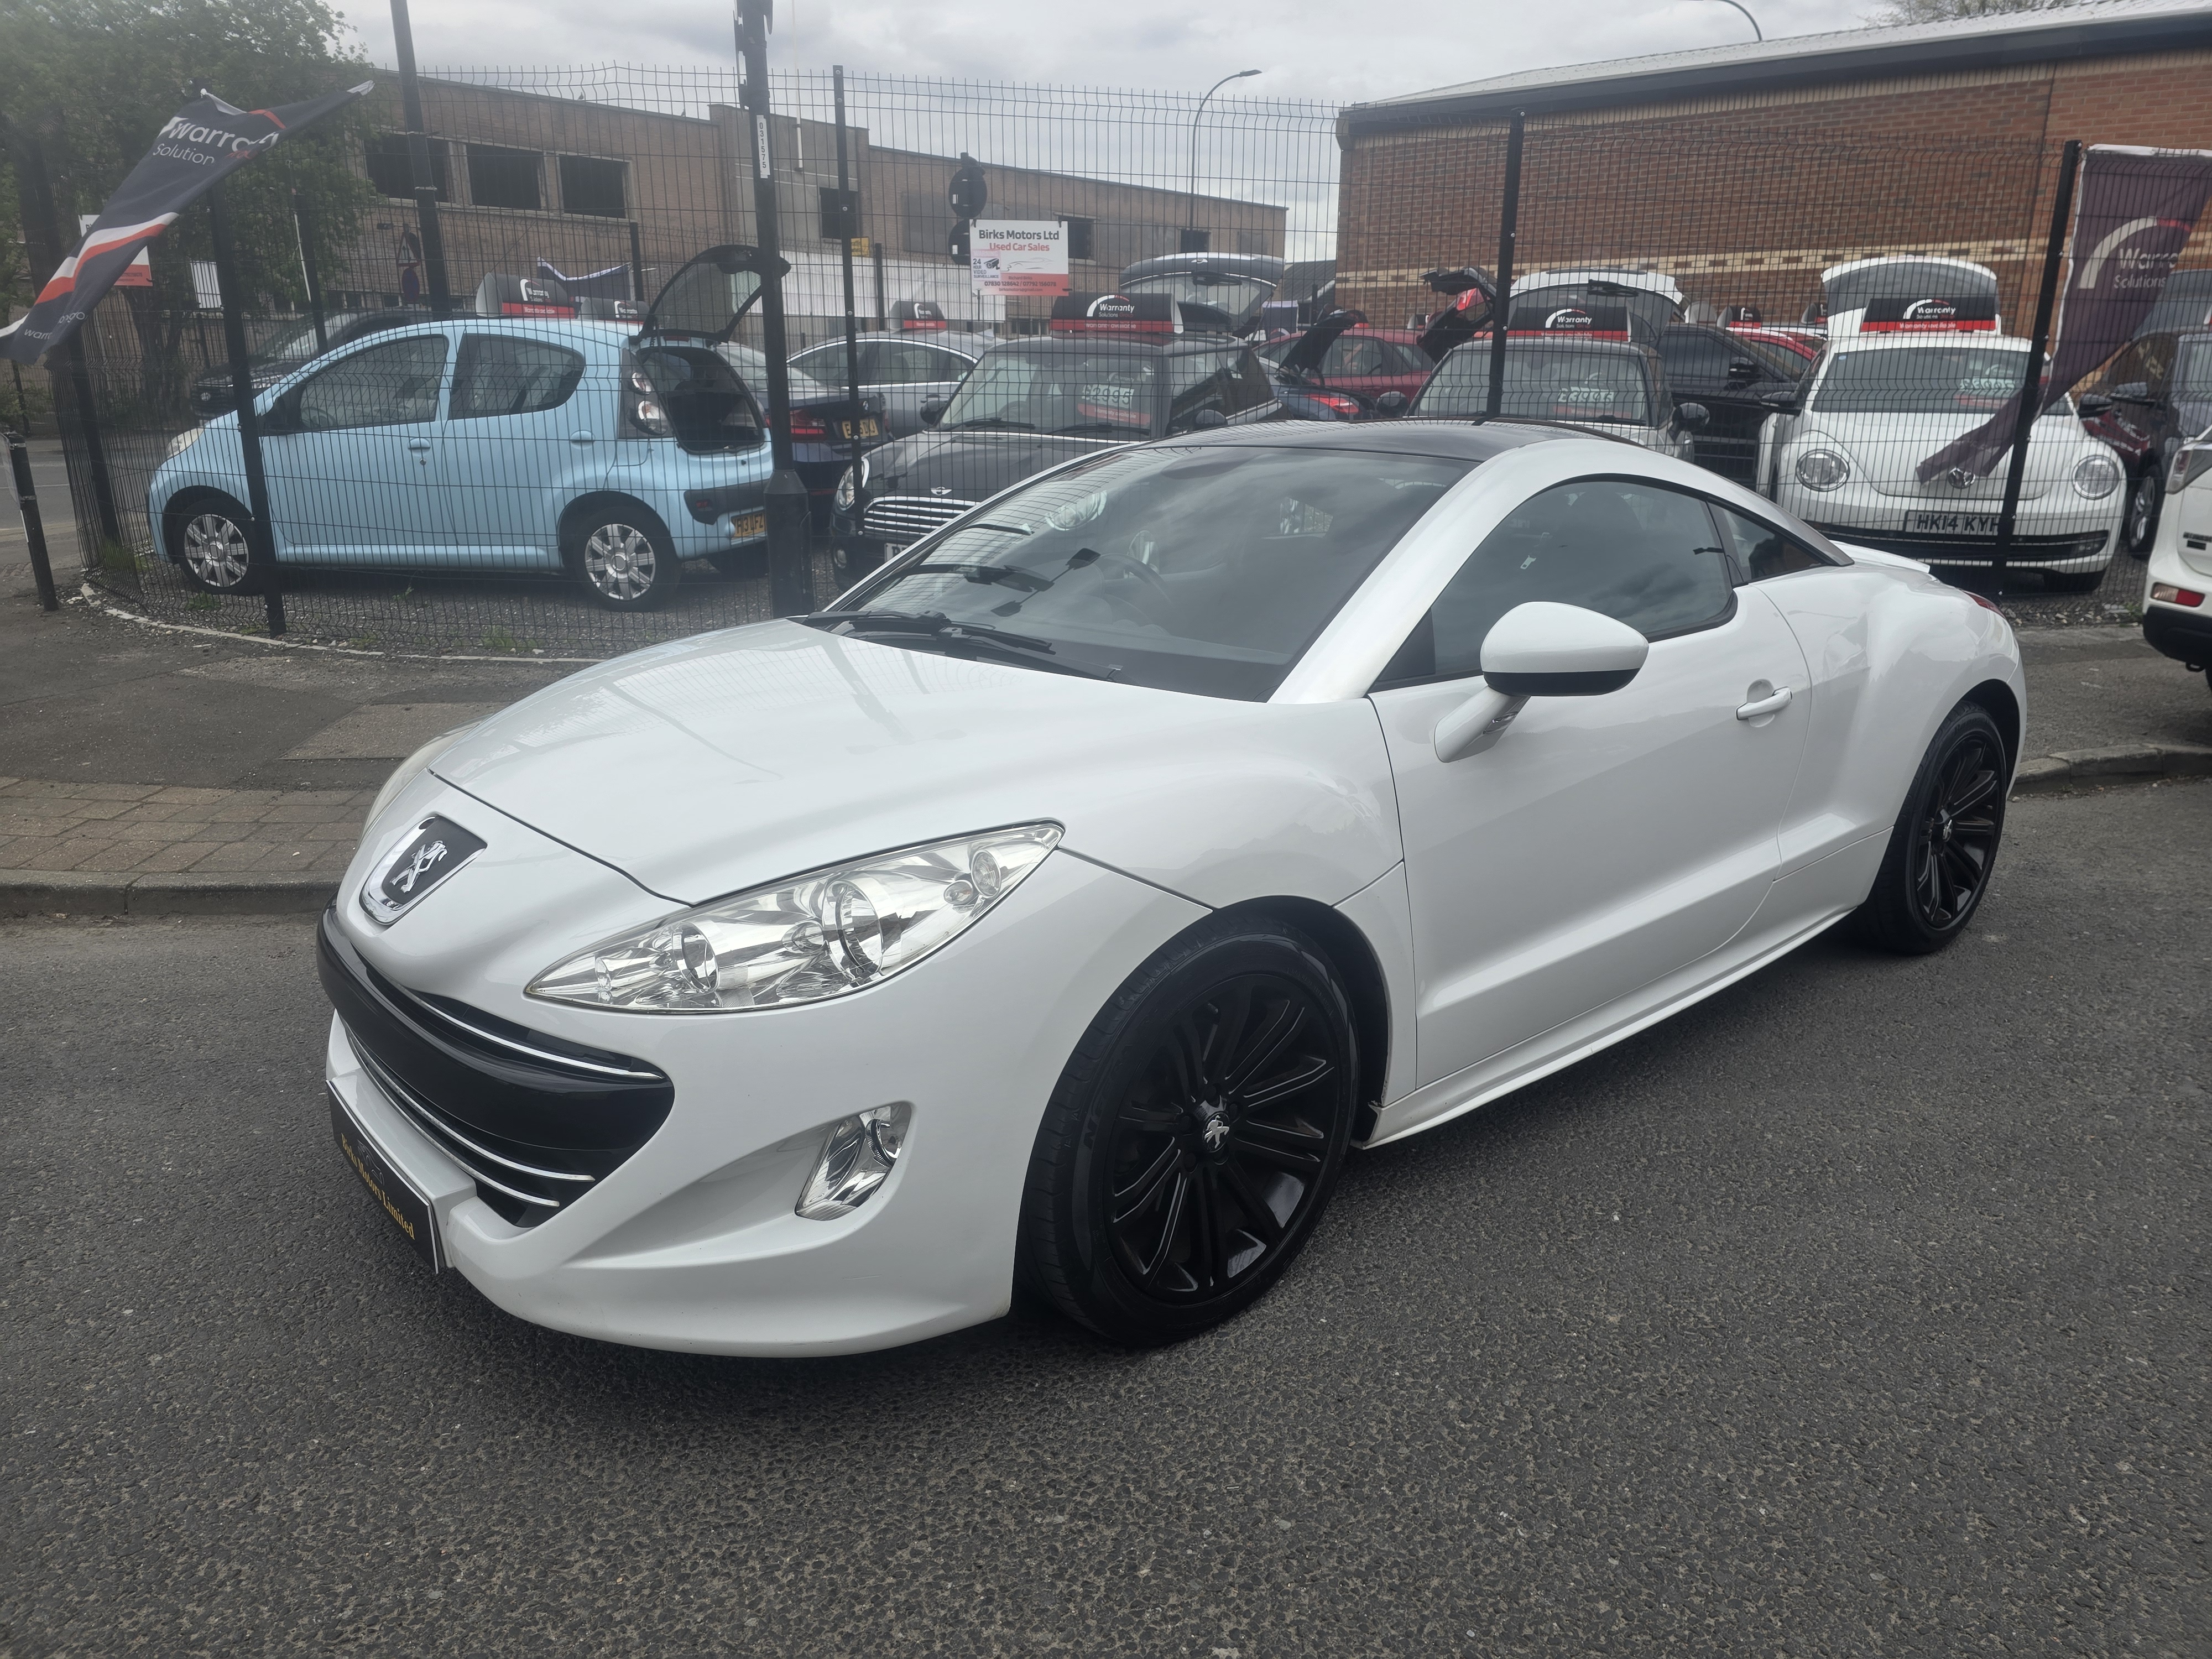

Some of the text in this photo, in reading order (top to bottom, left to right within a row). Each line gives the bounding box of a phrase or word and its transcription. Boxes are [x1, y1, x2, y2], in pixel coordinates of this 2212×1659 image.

[979, 229, 1060, 240] Birks Motors Ltd
[2114, 274, 2167, 289] Solutions
[1100, 304, 1135, 313] Warranty
[1917, 306, 1956, 316] Warranty
[1557, 316, 1593, 325] Warranty
[1082, 384, 1131, 405] £2995
[1917, 514, 1959, 531] HK14
[341, 1133, 415, 1240] Birks Motors Limited
